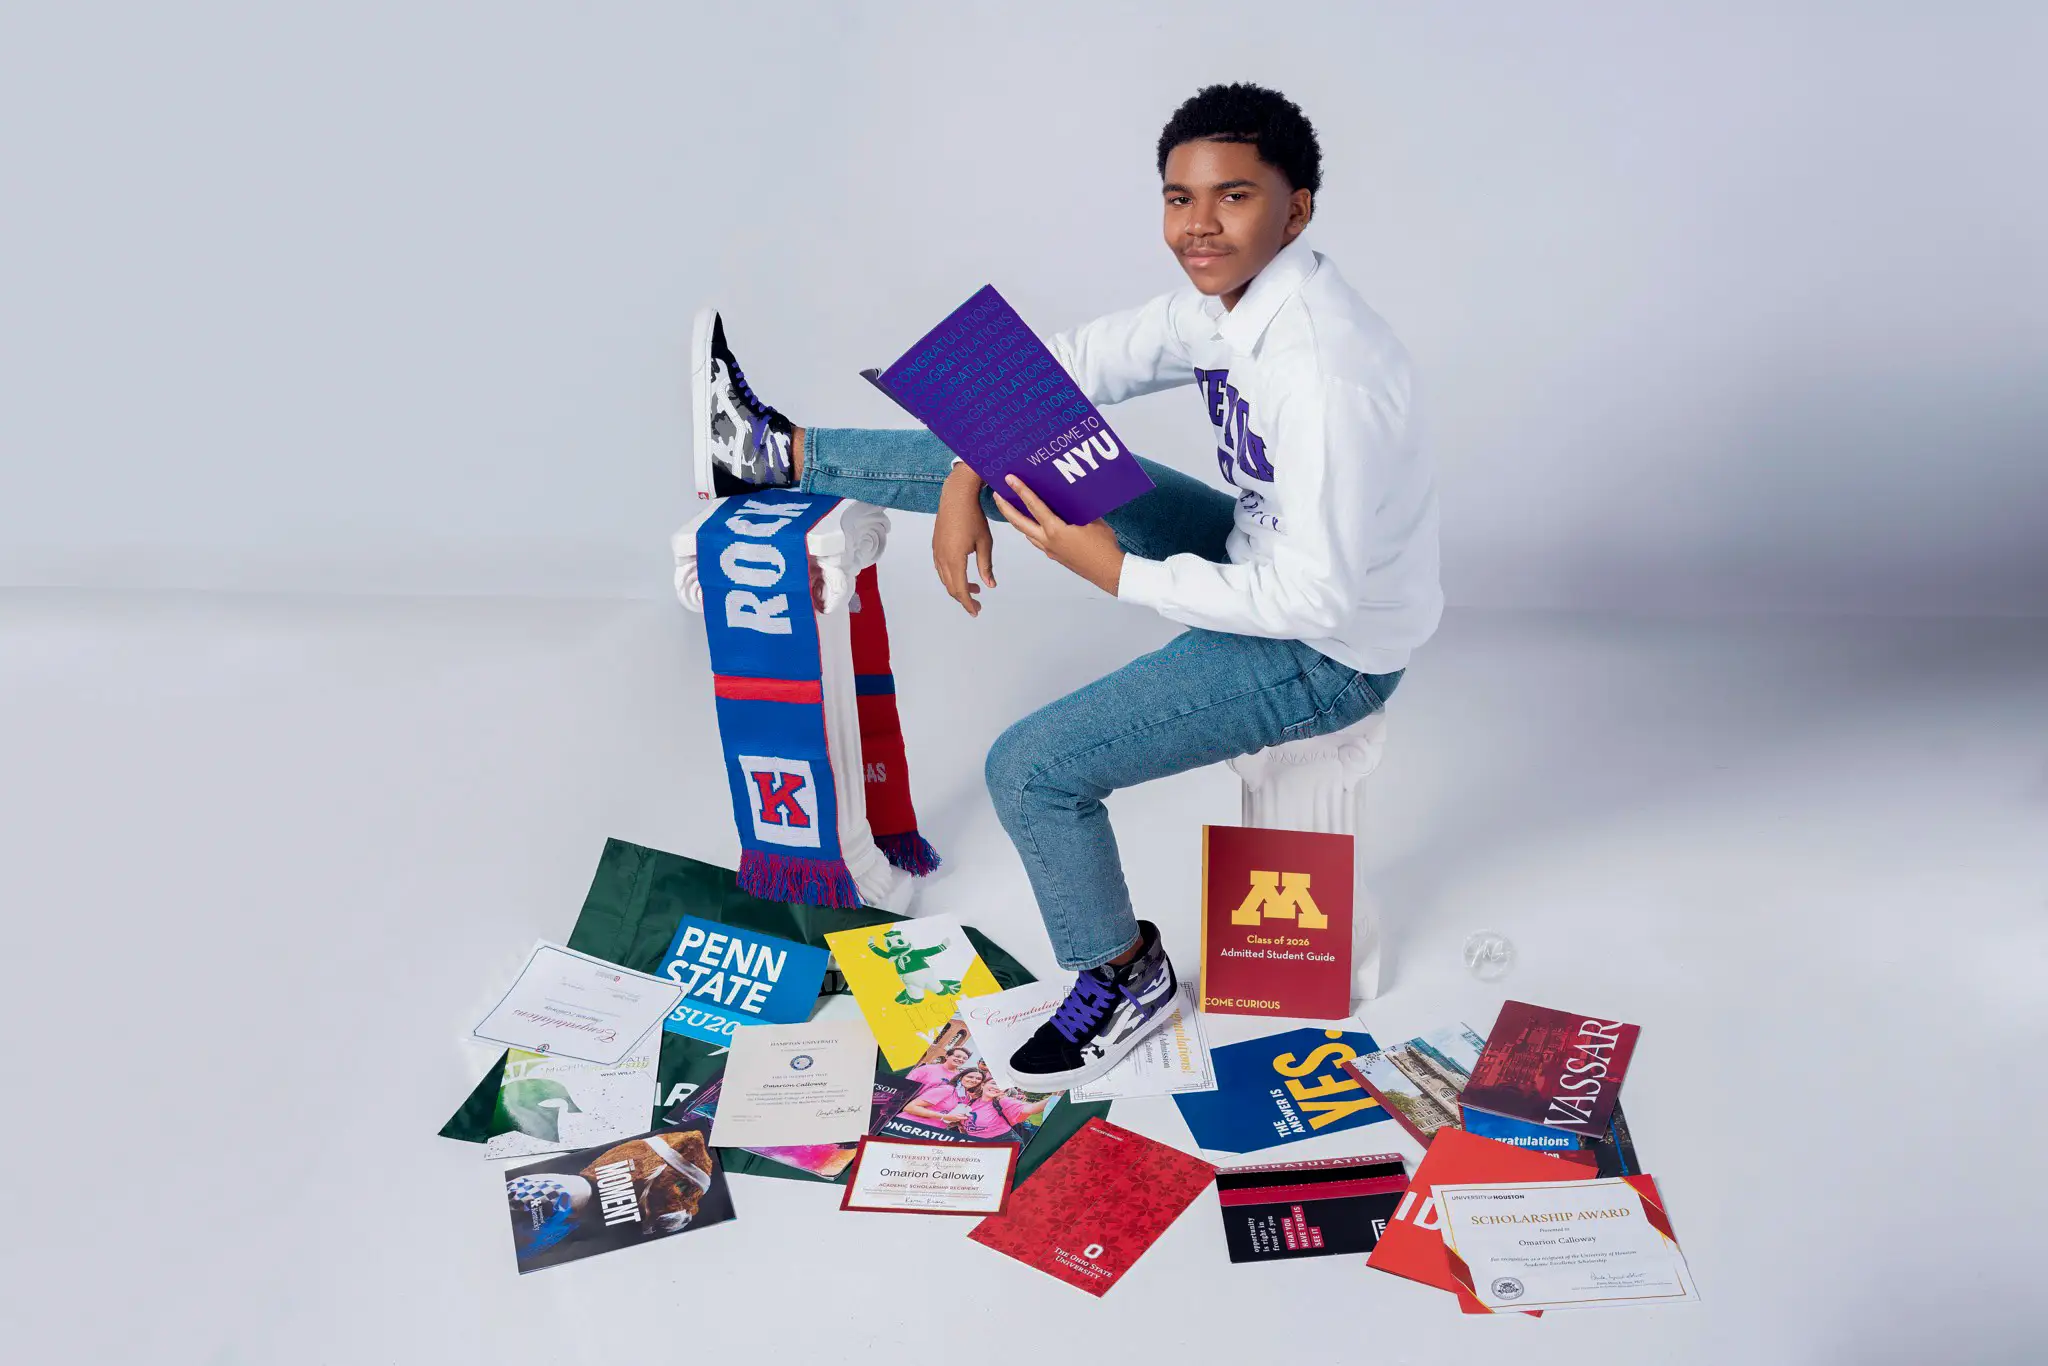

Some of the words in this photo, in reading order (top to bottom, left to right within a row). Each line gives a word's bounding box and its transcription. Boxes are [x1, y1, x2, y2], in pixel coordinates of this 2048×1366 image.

[891, 297, 1000, 391] CONGRATULATIONS
[904, 311, 1013, 402] CONGRATULATIONS
[917, 326, 1026, 416] CONGRATULATIONS
[930, 341, 1039, 428] CONGRATULATIONS
[943, 355, 1052, 440] CONGRATULATIONS
[957, 371, 1064, 452] CONGRATULATIONS
[970, 385, 1076, 465] CONGRATULATIONS
[983, 400, 1088, 477] CONGRATULATIONS
[1026, 428, 1083, 466] WELCOME
[1080, 416, 1099, 437] TO
[1052, 429, 1120, 484] NYU
[720, 498, 812, 634] ROCK
[752, 770, 811, 828] K
[1231, 870, 1328, 929] M
[676, 926, 787, 983] PENN
[1220, 948, 1264, 959] Admitted
[1266, 949, 1304, 961] Student
[1306, 952, 1335, 962] Guide
[1247, 935, 1272, 945] Class
[1274, 935, 1285, 945] of
[1287, 938, 1310, 946] 2026
[666, 960, 773, 1014] STATE
[1205, 997, 1233, 1007] COME
[1236, 999, 1280, 1010] CURIOUS
[512, 1009, 620, 1044] Congratulations
[1543, 1019, 1624, 1125] VASSAR
[1270, 1088, 1283, 1098] IS
[1273, 1121, 1291, 1138] THE
[1278, 1099, 1305, 1133] ANSWER
[880, 1168, 929, 1178] Omarion
[932, 1170, 985, 1182] Calloway
[1218, 1153, 1399, 1173] CONGRATULATIONS
[594, 1160, 642, 1227] MOMENT
[1267, 1215, 1276, 1227] you
[1284, 1218, 1292, 1231] YOU
[1295, 1213, 1303, 1222] DO
[1297, 1222, 1305, 1231] TO
[1471, 1212, 1573, 1225] SCHOLARSHIP
[1577, 1207, 1631, 1220] AWARD
[1248, 1217, 1260, 1253] opportunity
[1260, 1230, 1269, 1245] right
[1272, 1235, 1280, 1251] front
[1286, 1231, 1296, 1249] WHAT
[1299, 1231, 1309, 1248] HAVE
[1312, 1235, 1322, 1247] SEE
[1518, 1239, 1556, 1247] Omarion
[1558, 1236, 1597, 1246] Calloway
[1054, 1247, 1071, 1258] THE
[1071, 1254, 1089, 1266] OHIO
[1090, 1263, 1113, 1278] STATE
[1083, 1243, 1104, 1259] O
[1055, 1255, 1101, 1280] UNIVERSITY
